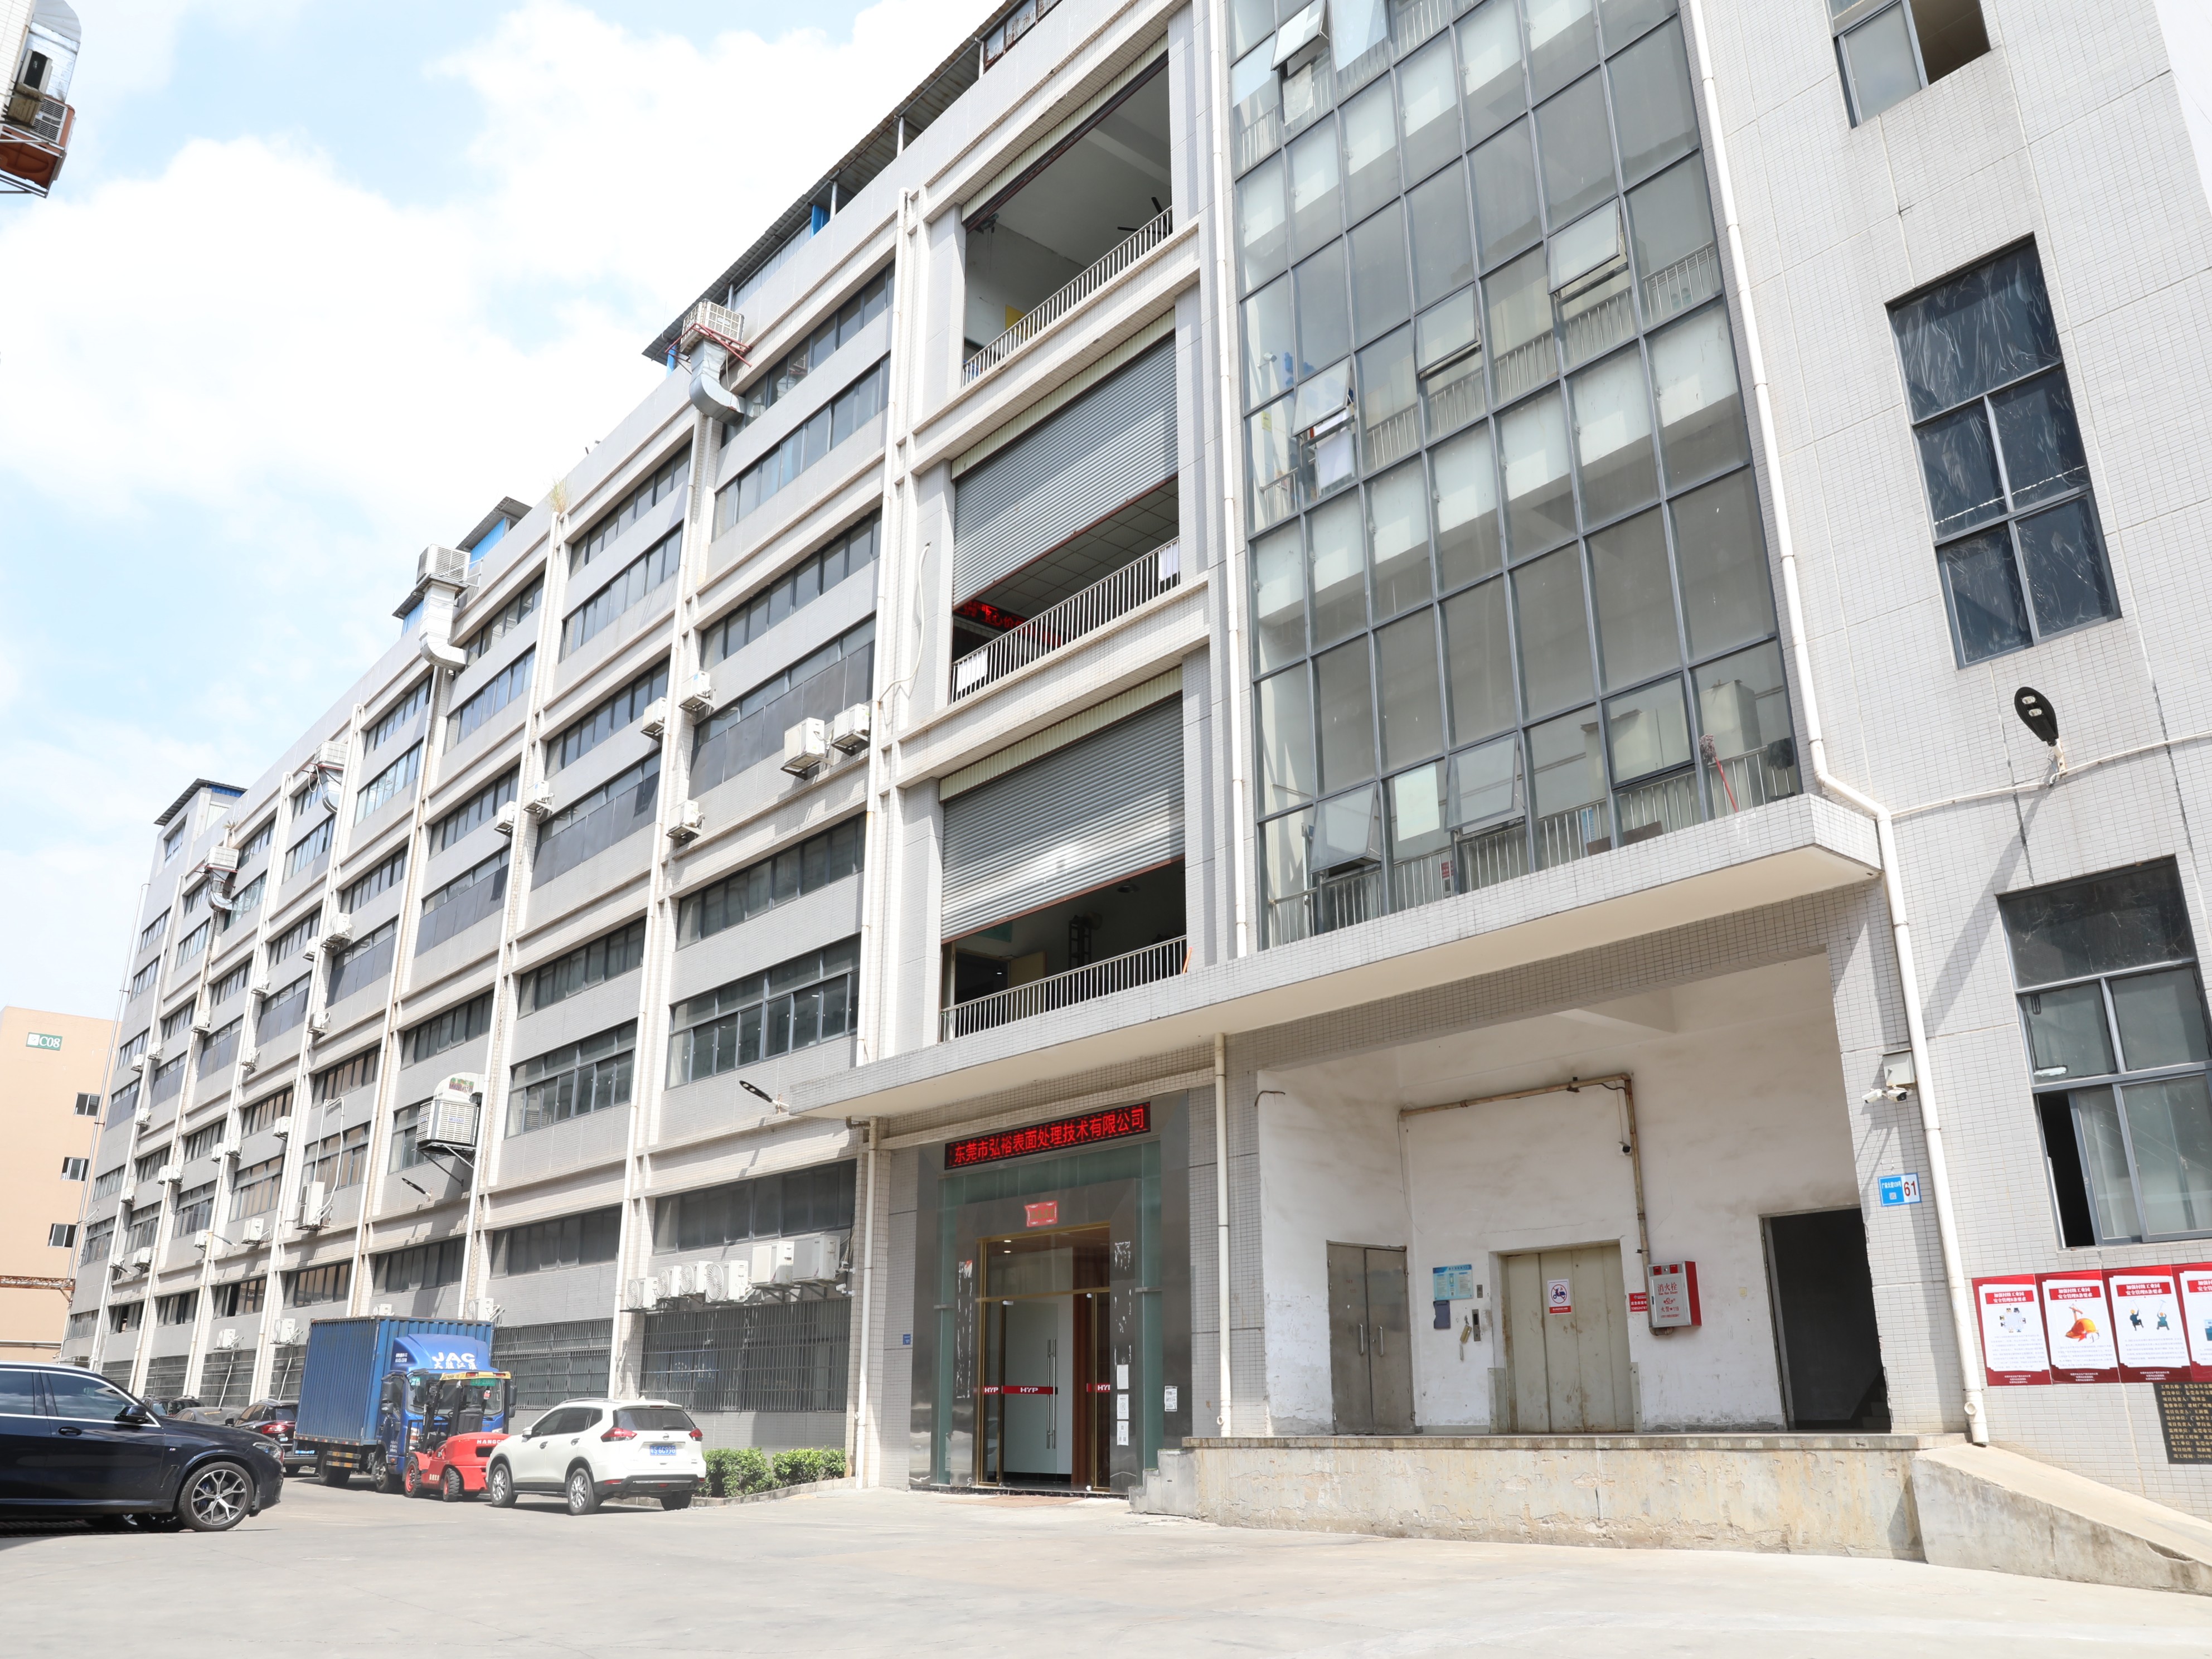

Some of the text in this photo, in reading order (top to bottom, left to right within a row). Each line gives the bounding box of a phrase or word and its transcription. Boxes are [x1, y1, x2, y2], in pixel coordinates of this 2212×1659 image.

[39, 1036, 61, 1048] C08
[954, 1108, 1144, 1163] 东莞市弘裕表面处理技术有限公司
[1904, 1181, 1917, 1196] 61
[1657, 1282, 1677, 1292] 消火栓
[431, 1352, 476, 1363] JAC
